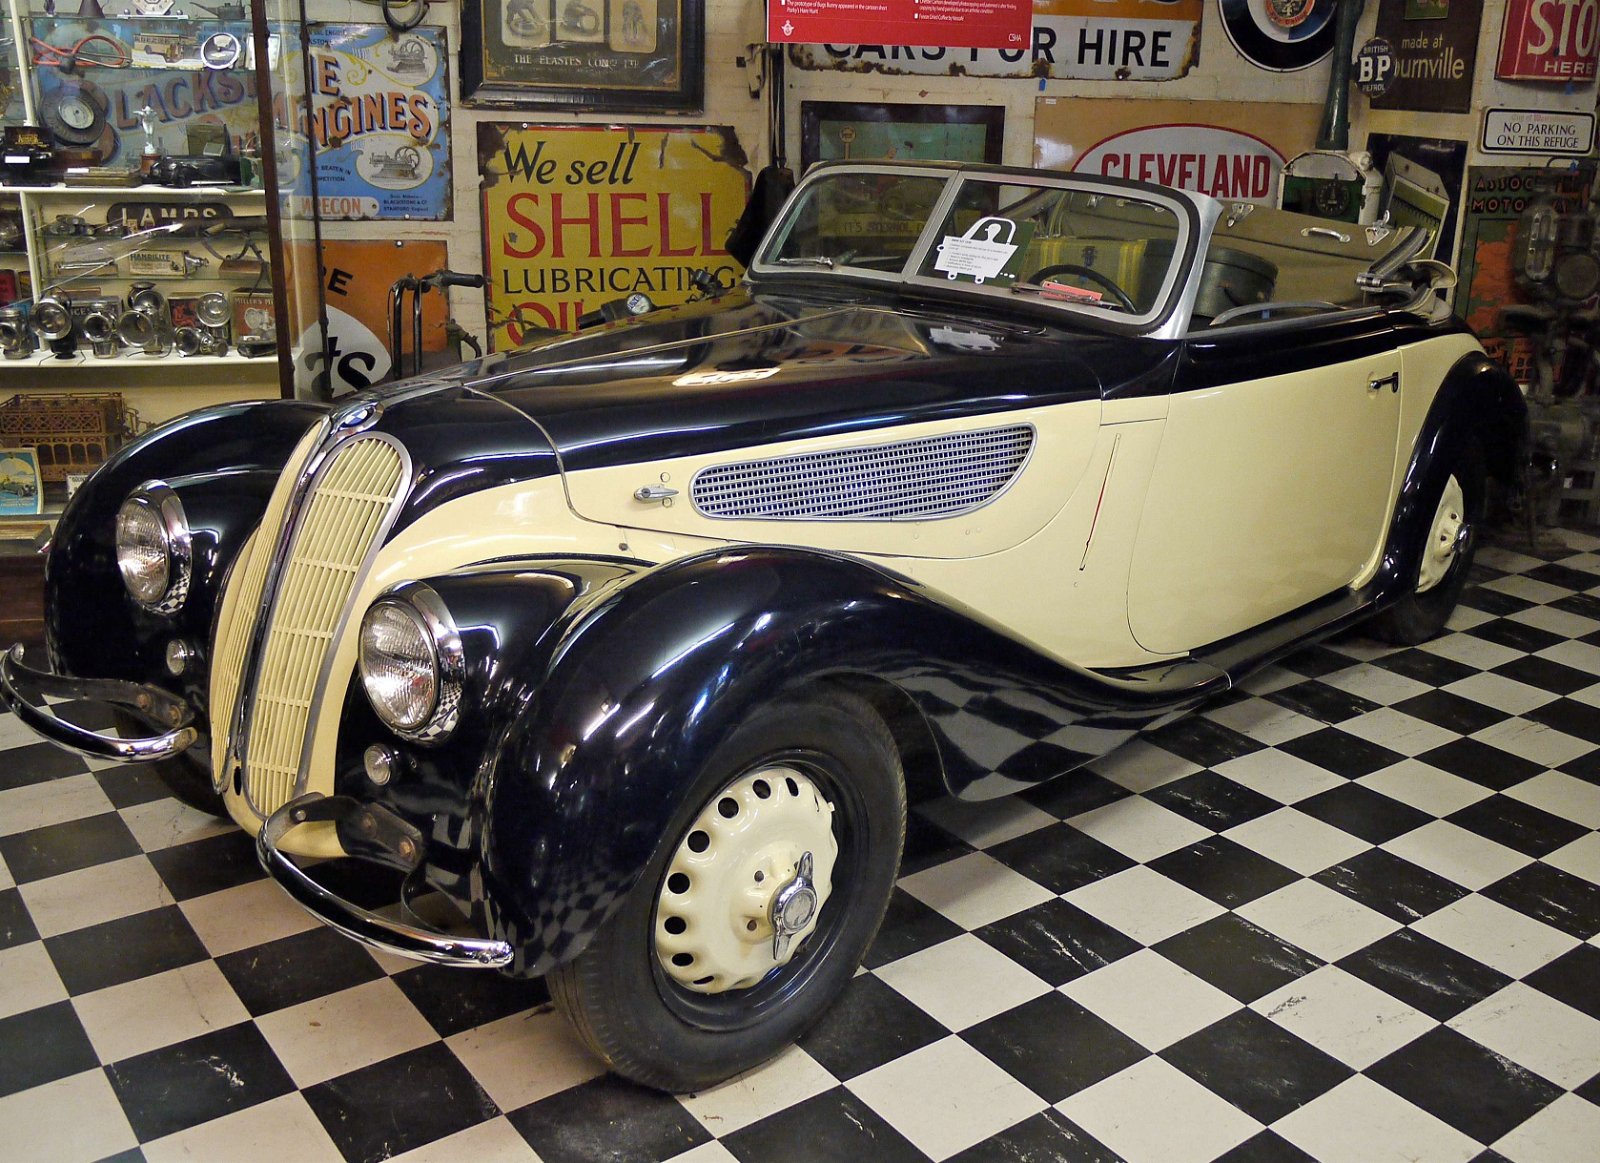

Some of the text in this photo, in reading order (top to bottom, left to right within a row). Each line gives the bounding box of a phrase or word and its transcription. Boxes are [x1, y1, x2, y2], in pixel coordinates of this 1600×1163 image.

[1077, 28, 1172, 68] HIRE
[1402, 31, 1443, 49] made at
[1363, 45, 1389, 54] BRITISH
[514, 54, 532, 64] THE
[1543, 60, 1594, 75] HERE
[1358, 55, 1391, 82] BP
[1362, 83, 1386, 92] PETROL
[1503, 122, 1576, 136] NO PARKING
[1497, 135, 1579, 149] ON THIS REFUGE
[503, 141, 642, 185] We sell
[1101, 153, 1271, 199] CLEVELAND
[503, 192, 733, 259] SHELL
[503, 266, 736, 295] LUBRICATING
